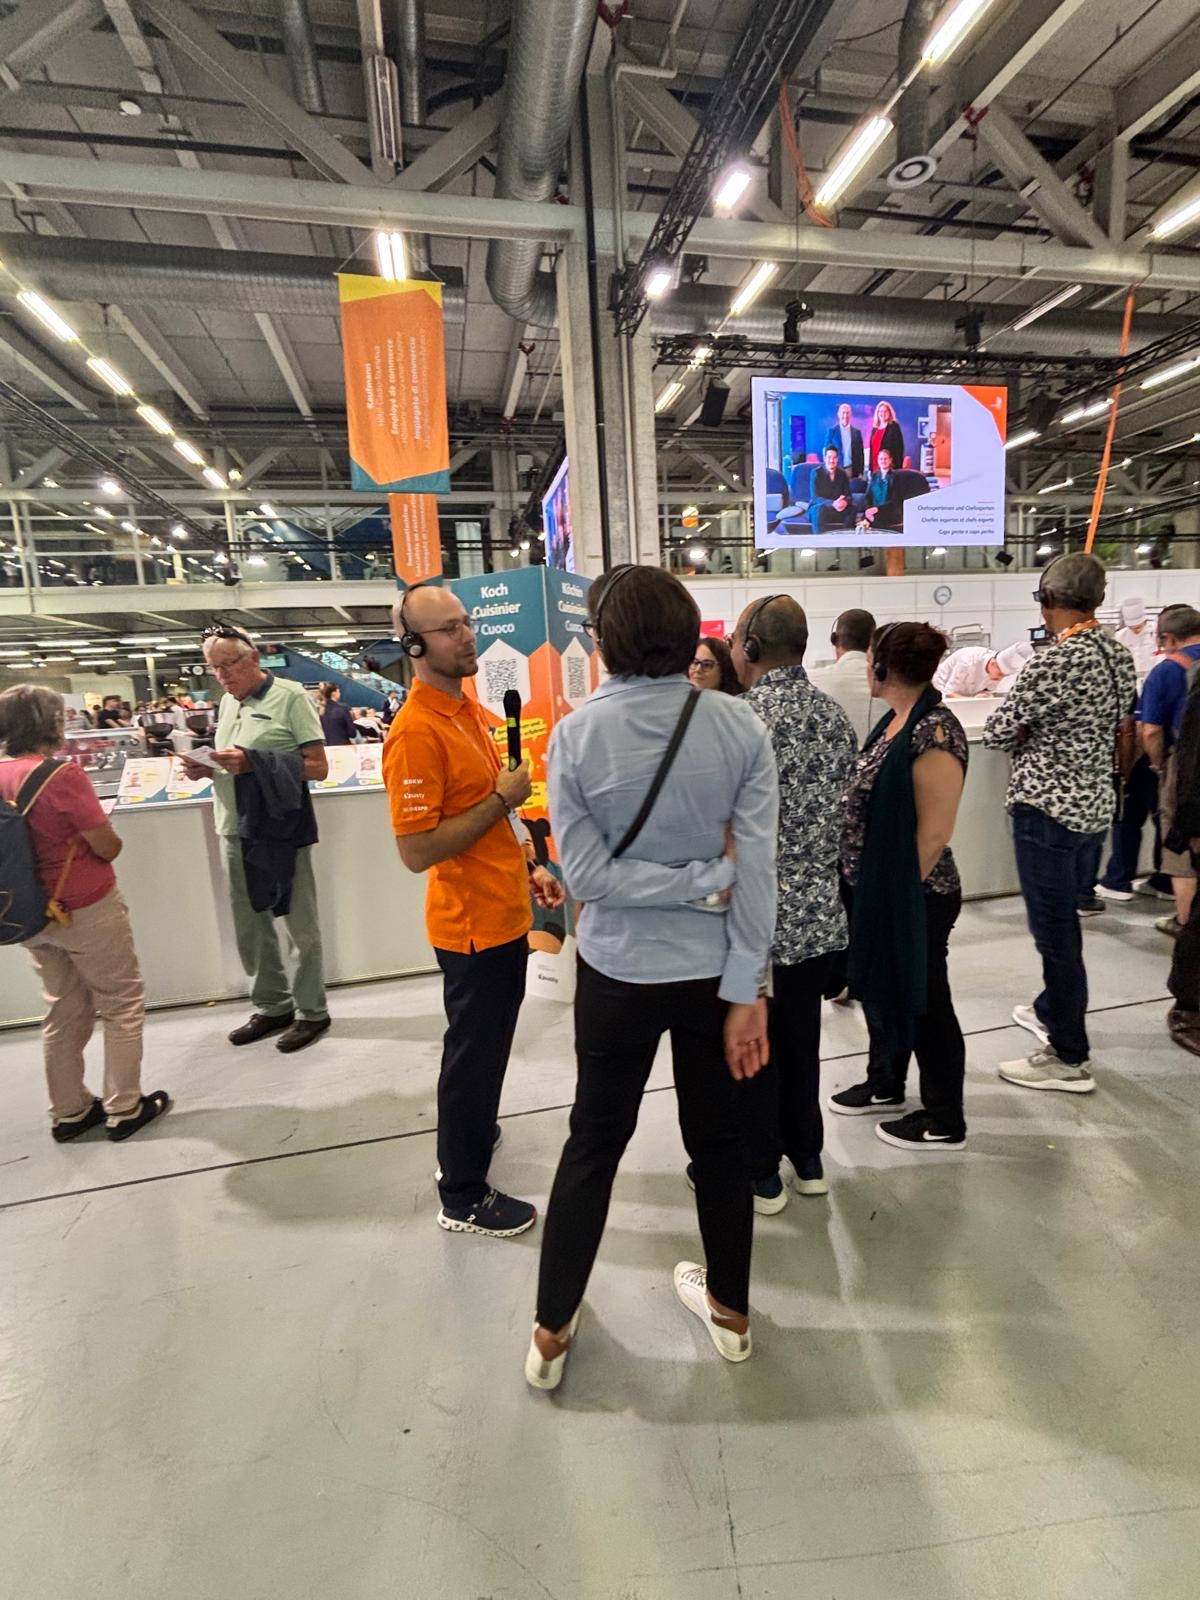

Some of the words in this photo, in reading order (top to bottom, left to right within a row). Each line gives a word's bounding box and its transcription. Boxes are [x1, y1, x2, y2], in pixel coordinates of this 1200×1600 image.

[386, 338, 397, 383] commerce
[364, 363, 375, 409] Kaufmann
[387, 385, 396, 397] de
[480, 583, 509, 599] Koch
[472, 602, 521, 618] Cuisinier
[481, 623, 515, 635] Cuoco
